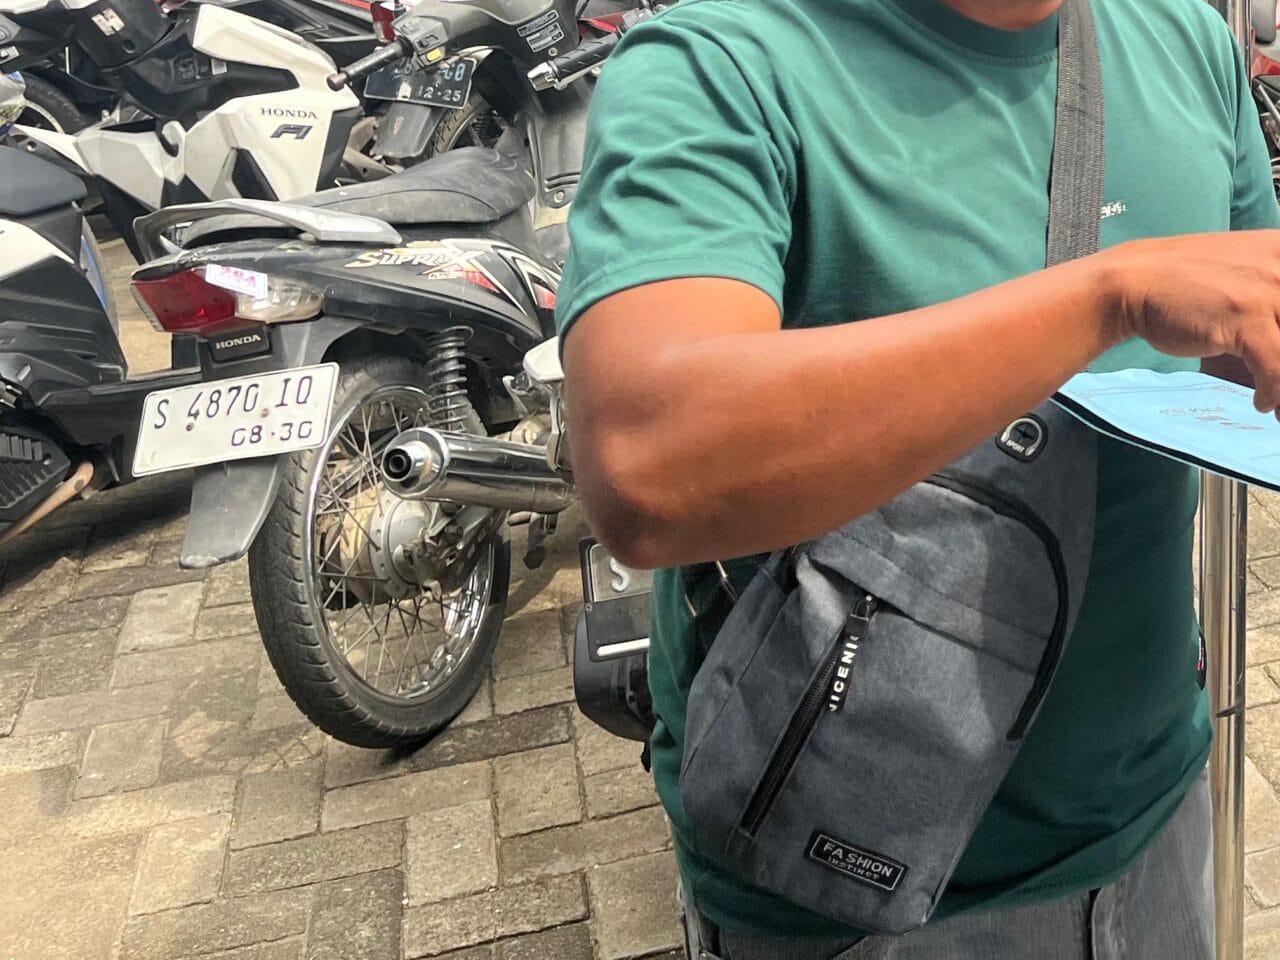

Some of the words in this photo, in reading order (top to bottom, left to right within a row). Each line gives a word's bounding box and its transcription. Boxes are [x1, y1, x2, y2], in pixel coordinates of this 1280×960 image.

[260, 107, 319, 119] HONDA
[216, 334, 262, 350] HONDA
[154, 399, 169, 429] S
[188, 383, 259, 421] 4870
[823, 841, 894, 878] FASHION
